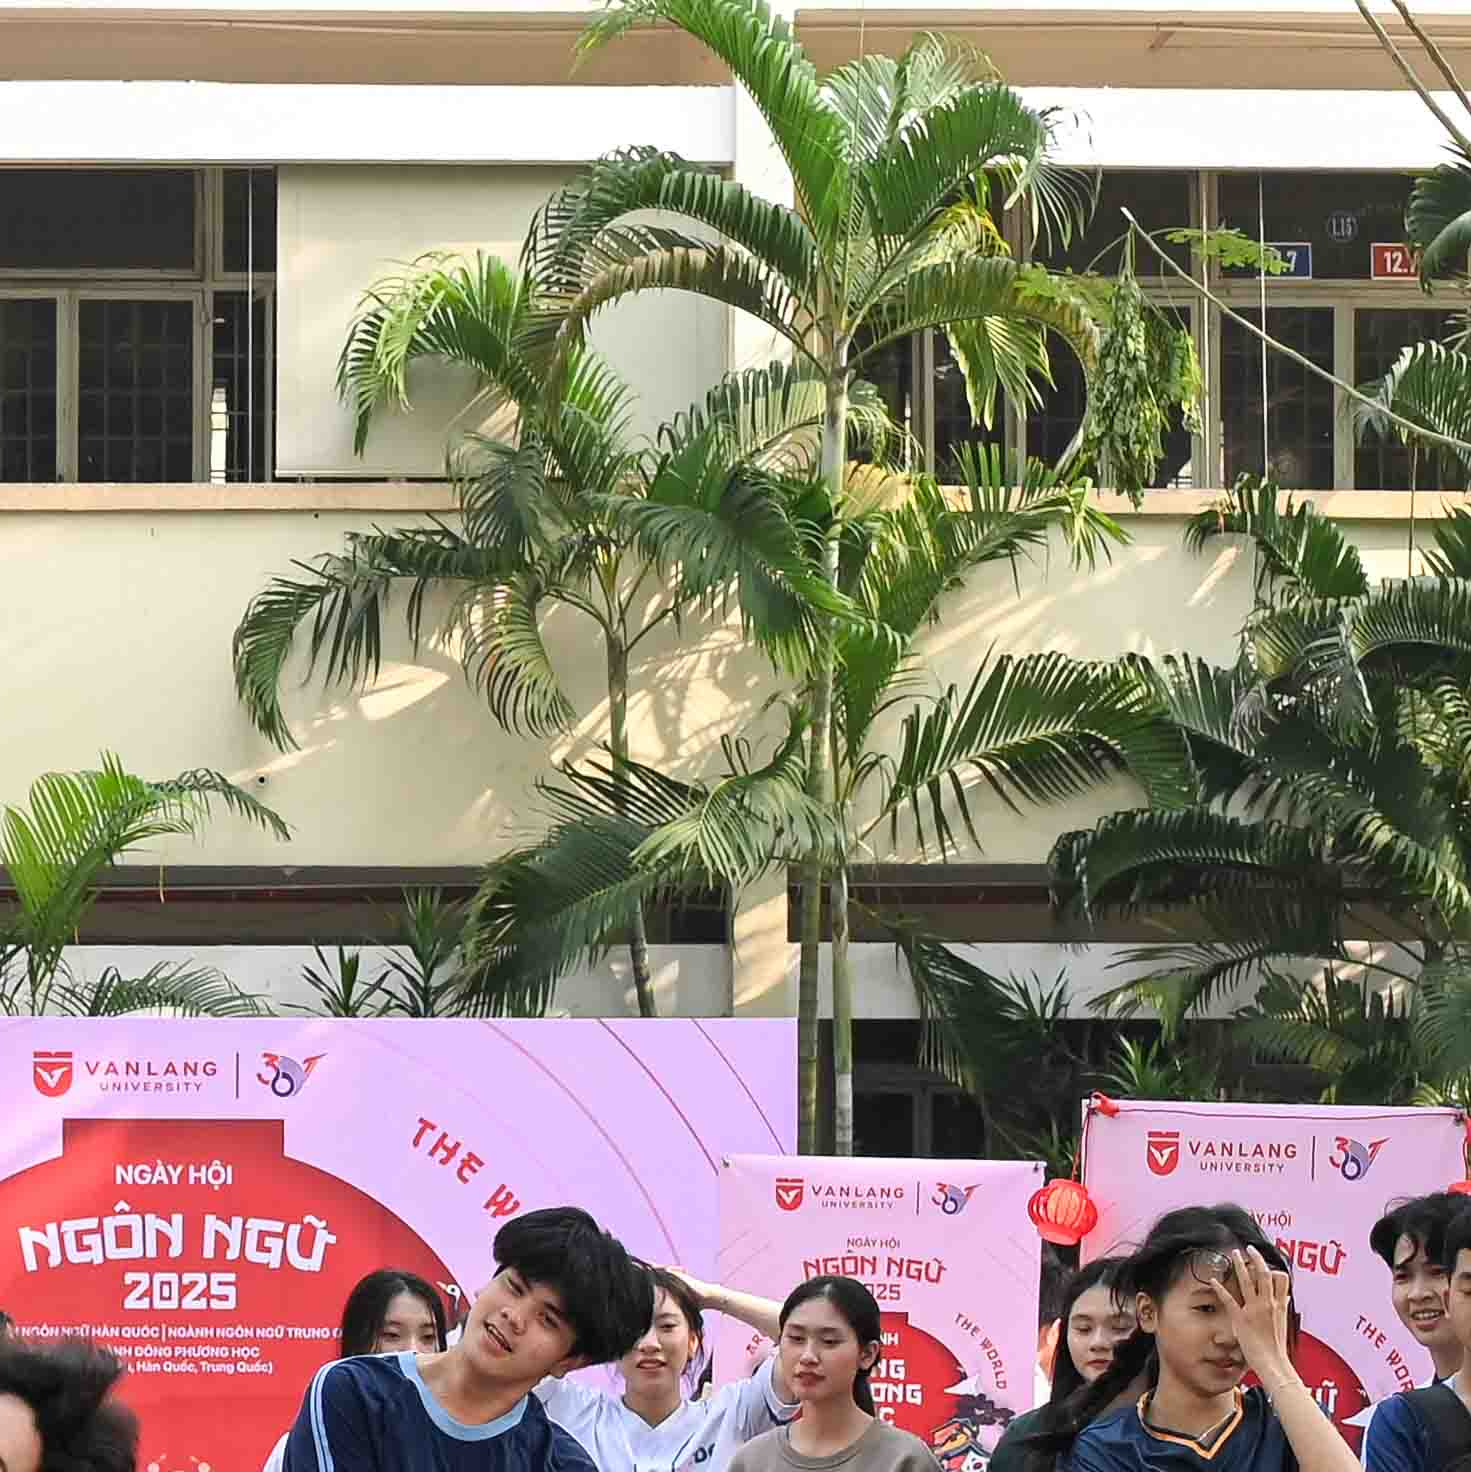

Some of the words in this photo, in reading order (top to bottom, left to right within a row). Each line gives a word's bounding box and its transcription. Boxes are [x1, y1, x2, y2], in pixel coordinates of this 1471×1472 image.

[84, 1060, 218, 1078] VANLANG
[99, 1081, 204, 1093] UNIVERSITY
[412, 1117, 485, 1185] THE
[1187, 1140, 1297, 1159] VANLANG
[115, 1160, 182, 1186] NGÀY
[188, 1160, 233, 1190] HỘI
[1199, 1161, 1285, 1174] UNIVERSITY
[811, 1185, 905, 1200] VANLANG
[820, 1200, 895, 1210] UNIVERSITY
[1267, 1213, 1293, 1230] HỘI
[17, 1200, 184, 1272] NGÔN
[202, 1213, 337, 1273] NGỮ
[846, 1237, 877, 1250] NGÀY
[1274, 1236, 1347, 1276] NGỮ
[802, 1249, 878, 1280] NGÔN
[886, 1256, 947, 1285] NGỮ
[123, 1272, 237, 1310] 2025
[863, 1283, 902, 1301] 025
[167, 1323, 215, 1339] NGÀNH
[216, 1323, 254, 1339] NGÔN
[256, 1323, 285, 1339] NGỮ
[287, 1326, 330, 1339] TRUNG
[1355, 1314, 1387, 1350] THE
[174, 1345, 229, 1358] PHƯƠNG
[231, 1346, 261, 1362] HỌC
[954, 1312, 981, 1338] THE
[980, 1338, 1008, 1391] WORLD
